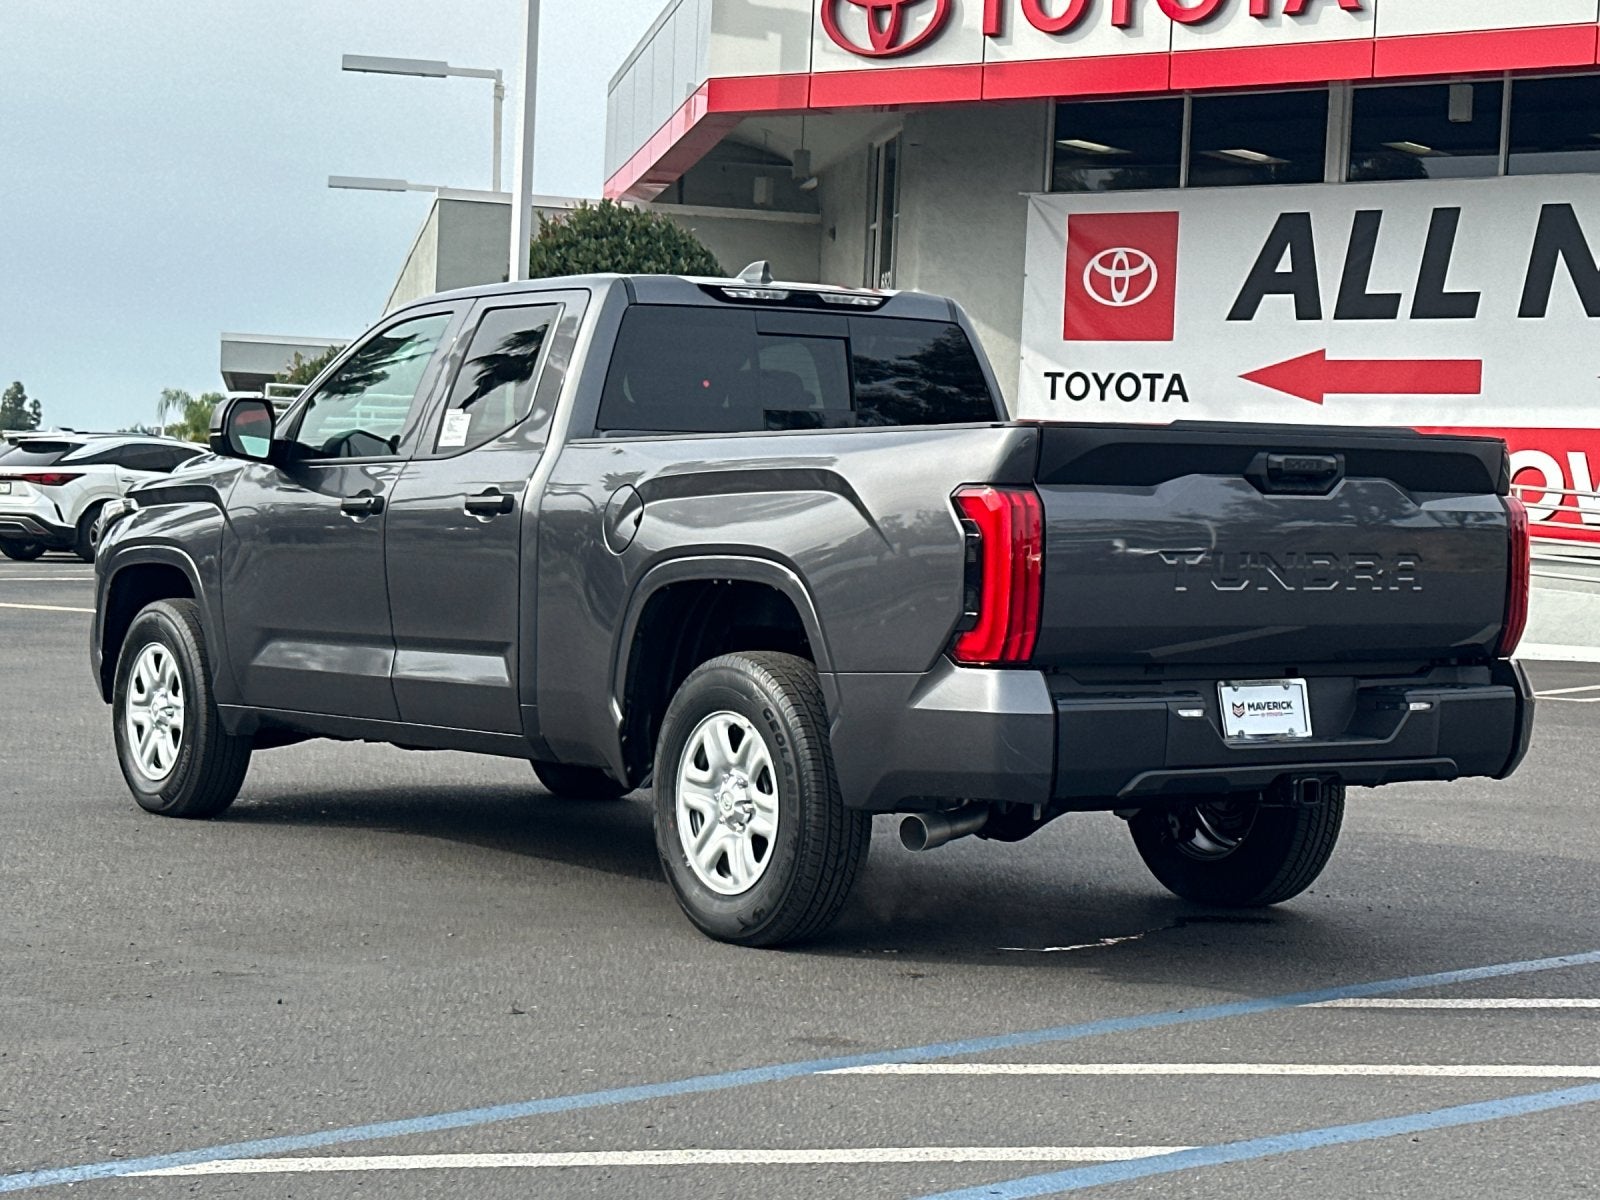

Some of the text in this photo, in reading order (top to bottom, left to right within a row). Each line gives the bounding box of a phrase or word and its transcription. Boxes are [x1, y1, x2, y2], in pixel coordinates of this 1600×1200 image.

[1226, 206, 1481, 320] ALL
[1044, 372, 1189, 402] TOYOTA
[1159, 550, 1422, 591] TUNDRA
[1247, 700, 1293, 712] MAVERICK
